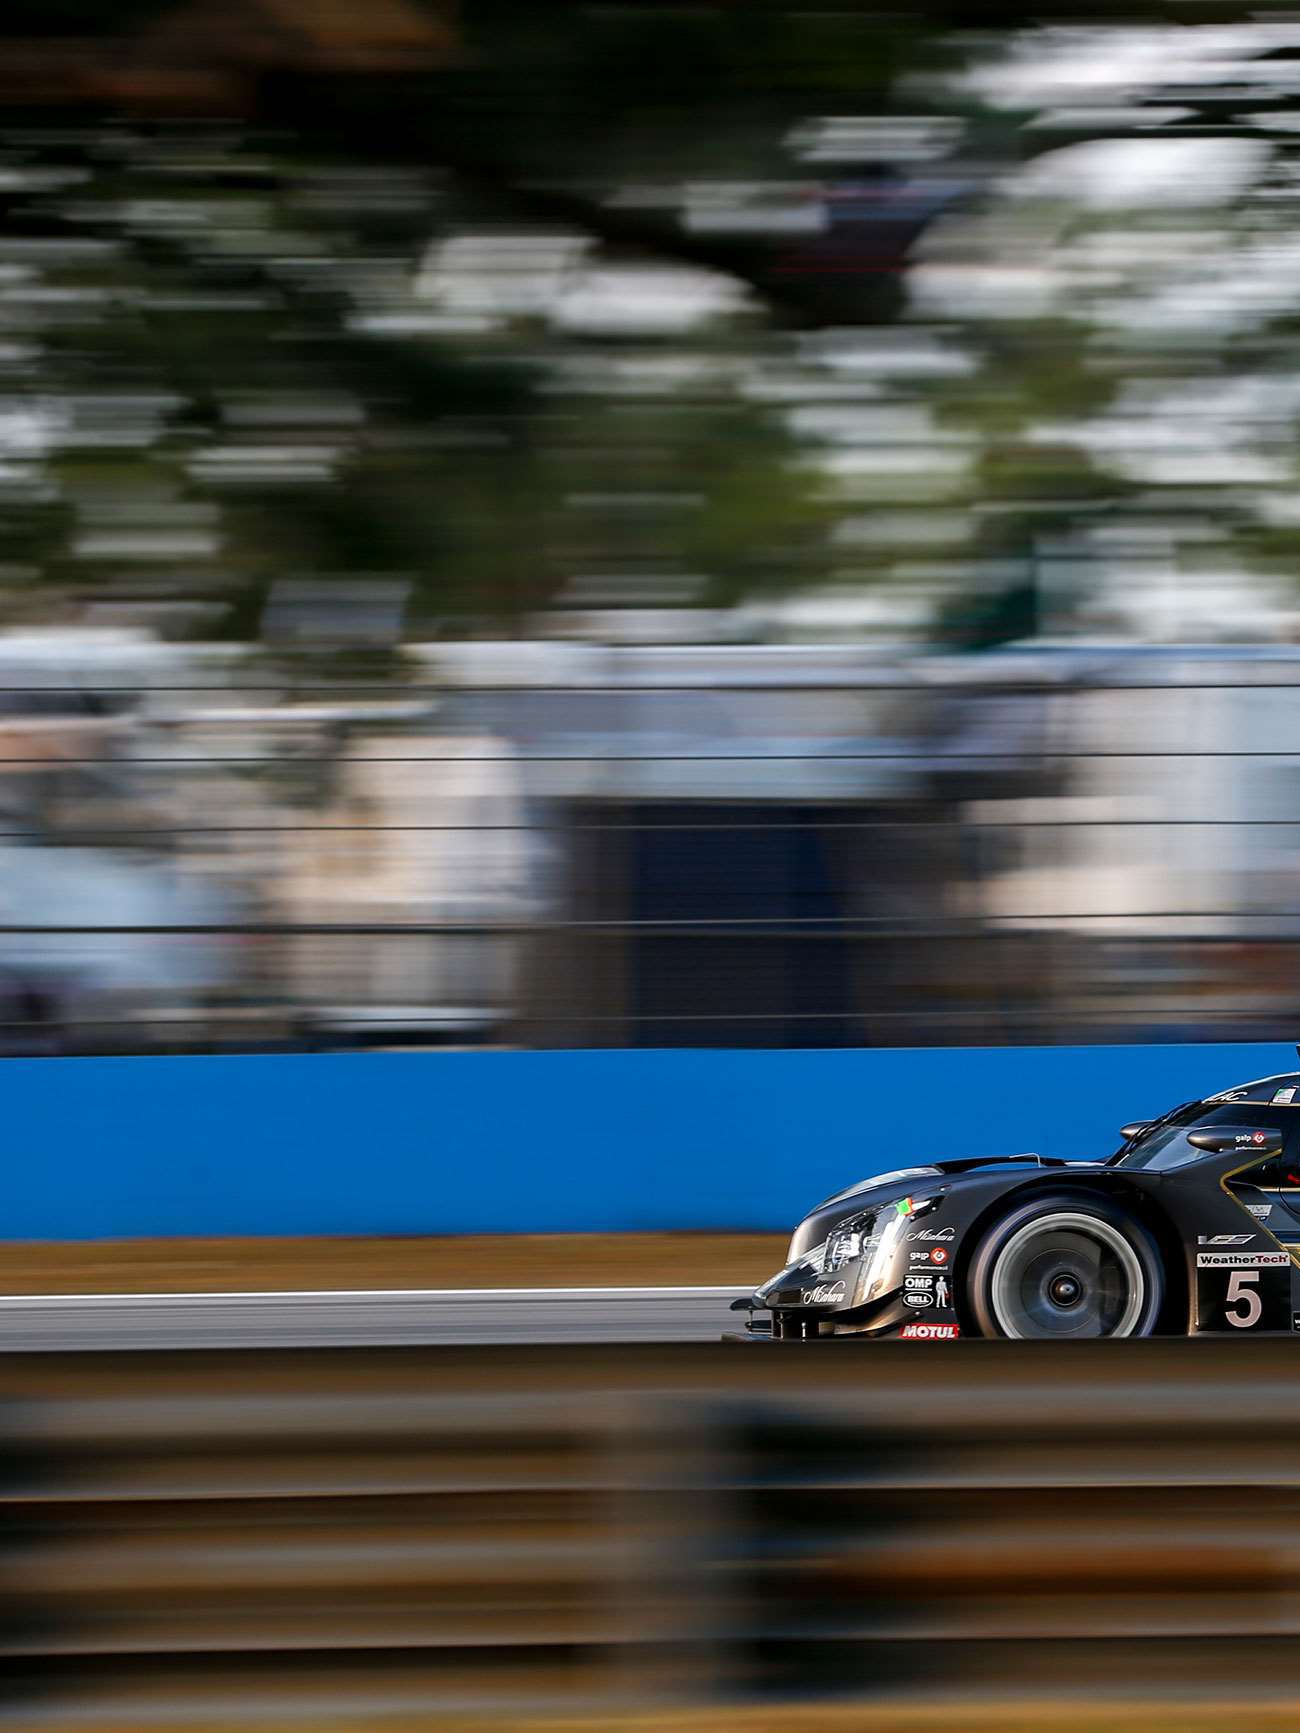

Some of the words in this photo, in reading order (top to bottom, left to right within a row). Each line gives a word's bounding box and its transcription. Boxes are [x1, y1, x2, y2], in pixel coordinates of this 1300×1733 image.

[1200, 1254, 1287, 1264] WeatherTech
[904, 1277, 933, 1289] OMP
[907, 1295, 930, 1304] BELL
[1225, 1270, 1262, 1328] 5
[902, 1325, 956, 1338] MOTUL
